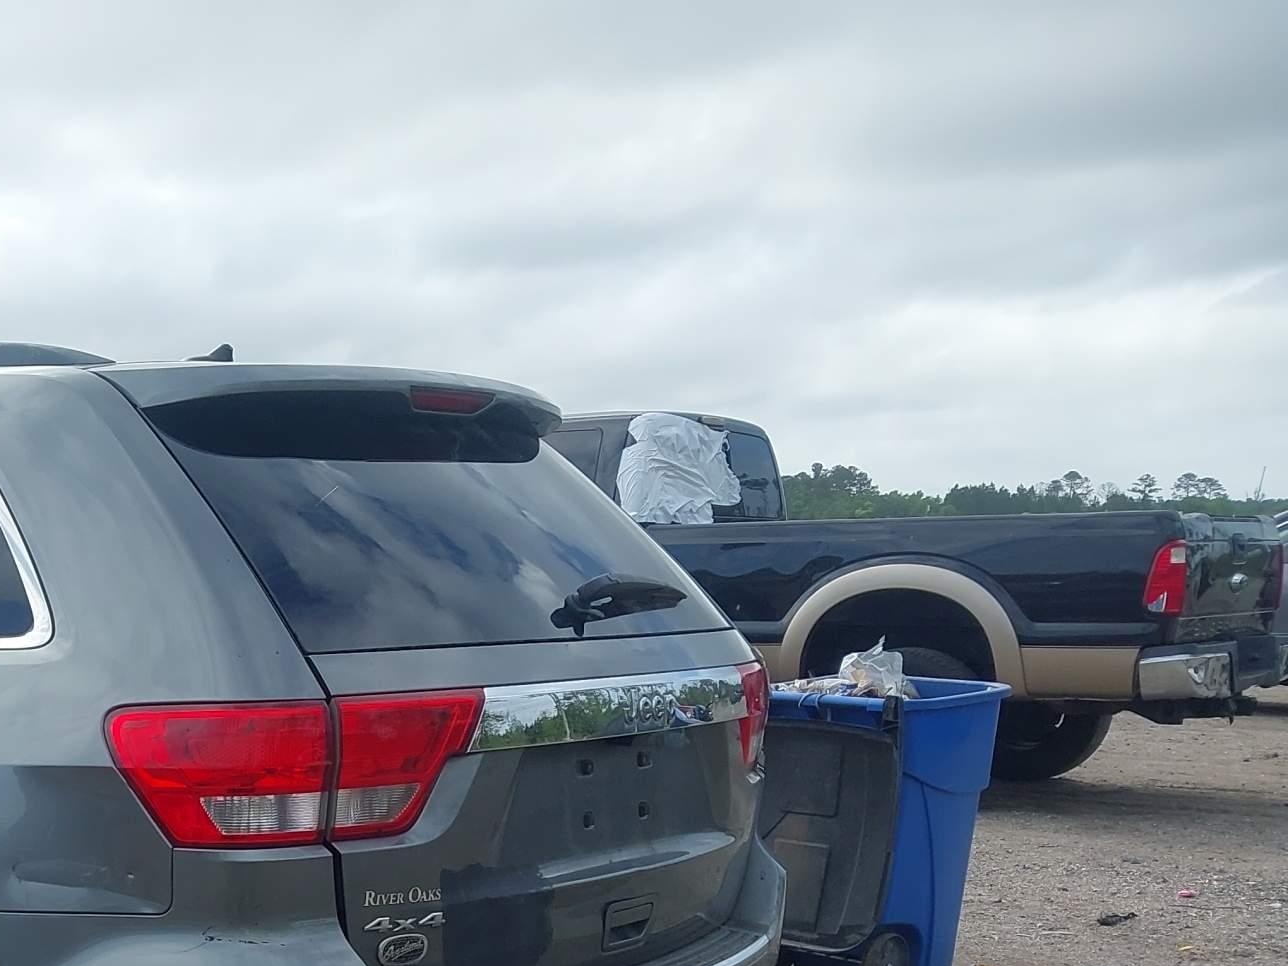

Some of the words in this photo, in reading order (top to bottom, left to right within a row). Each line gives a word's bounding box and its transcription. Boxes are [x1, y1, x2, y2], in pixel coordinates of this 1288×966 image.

[623, 689, 677, 729] Jeep
[363, 890, 404, 907] RIVER
[408, 886, 442, 903] OAKS
